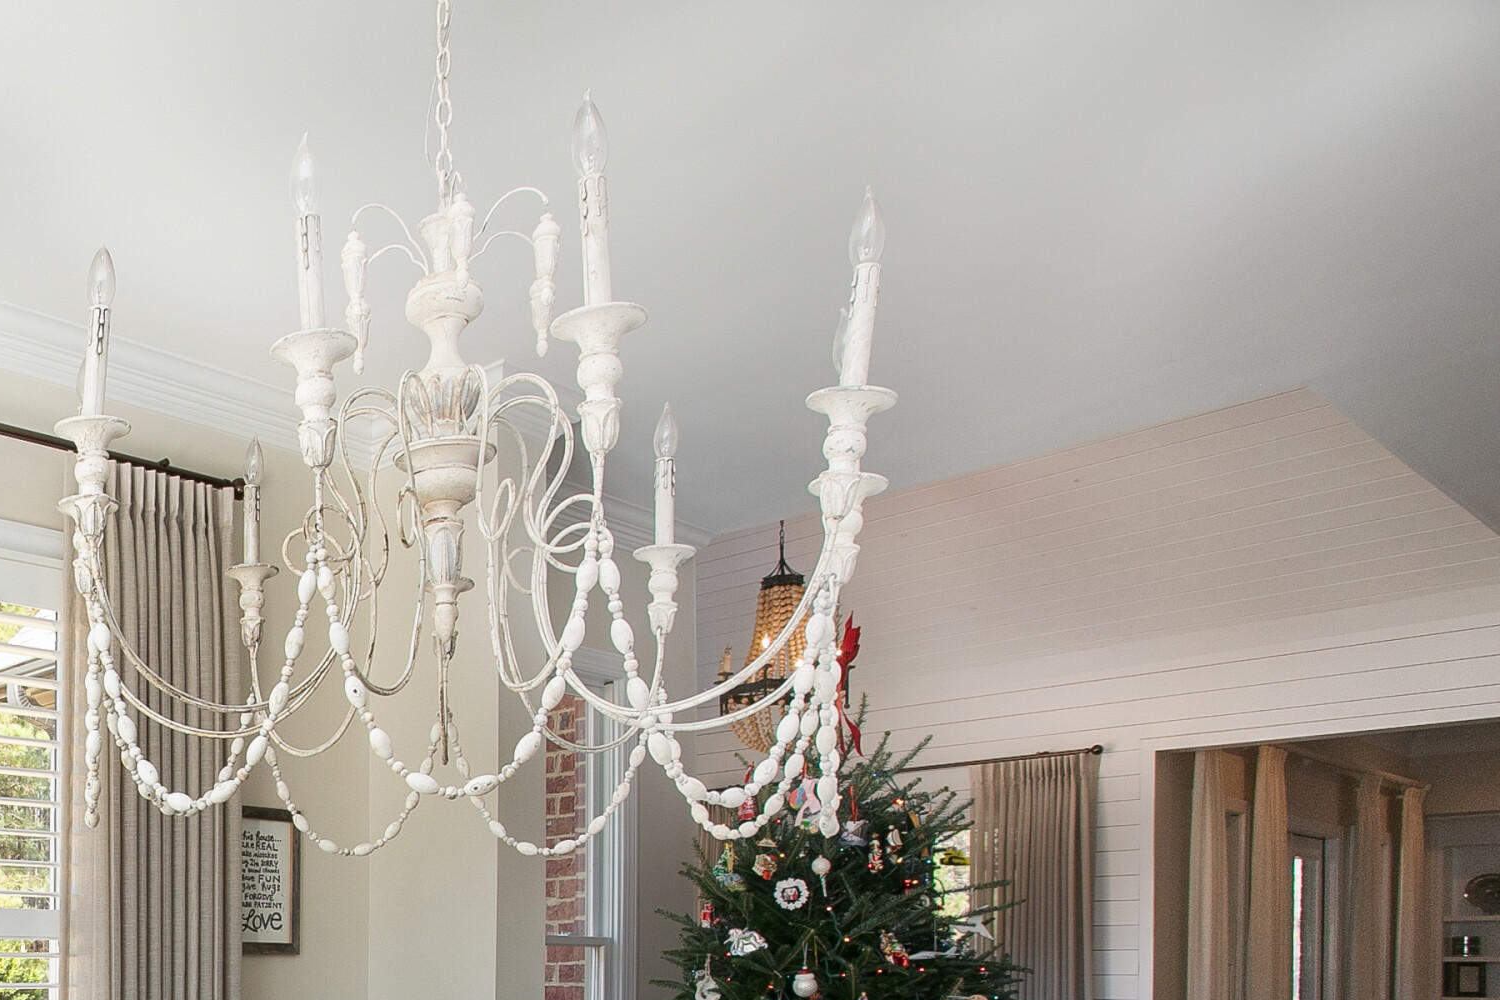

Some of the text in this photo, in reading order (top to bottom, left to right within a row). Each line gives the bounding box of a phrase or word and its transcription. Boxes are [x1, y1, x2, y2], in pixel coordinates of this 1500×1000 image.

[242, 830, 253, 841] his
[256, 841, 278, 851] REAL
[258, 874, 280, 884] FUN
[261, 881, 280, 895] hugs
[244, 892, 275, 902] FORGIVE
[254, 901, 283, 909] PATIENT
[241, 908, 283, 932] Love
